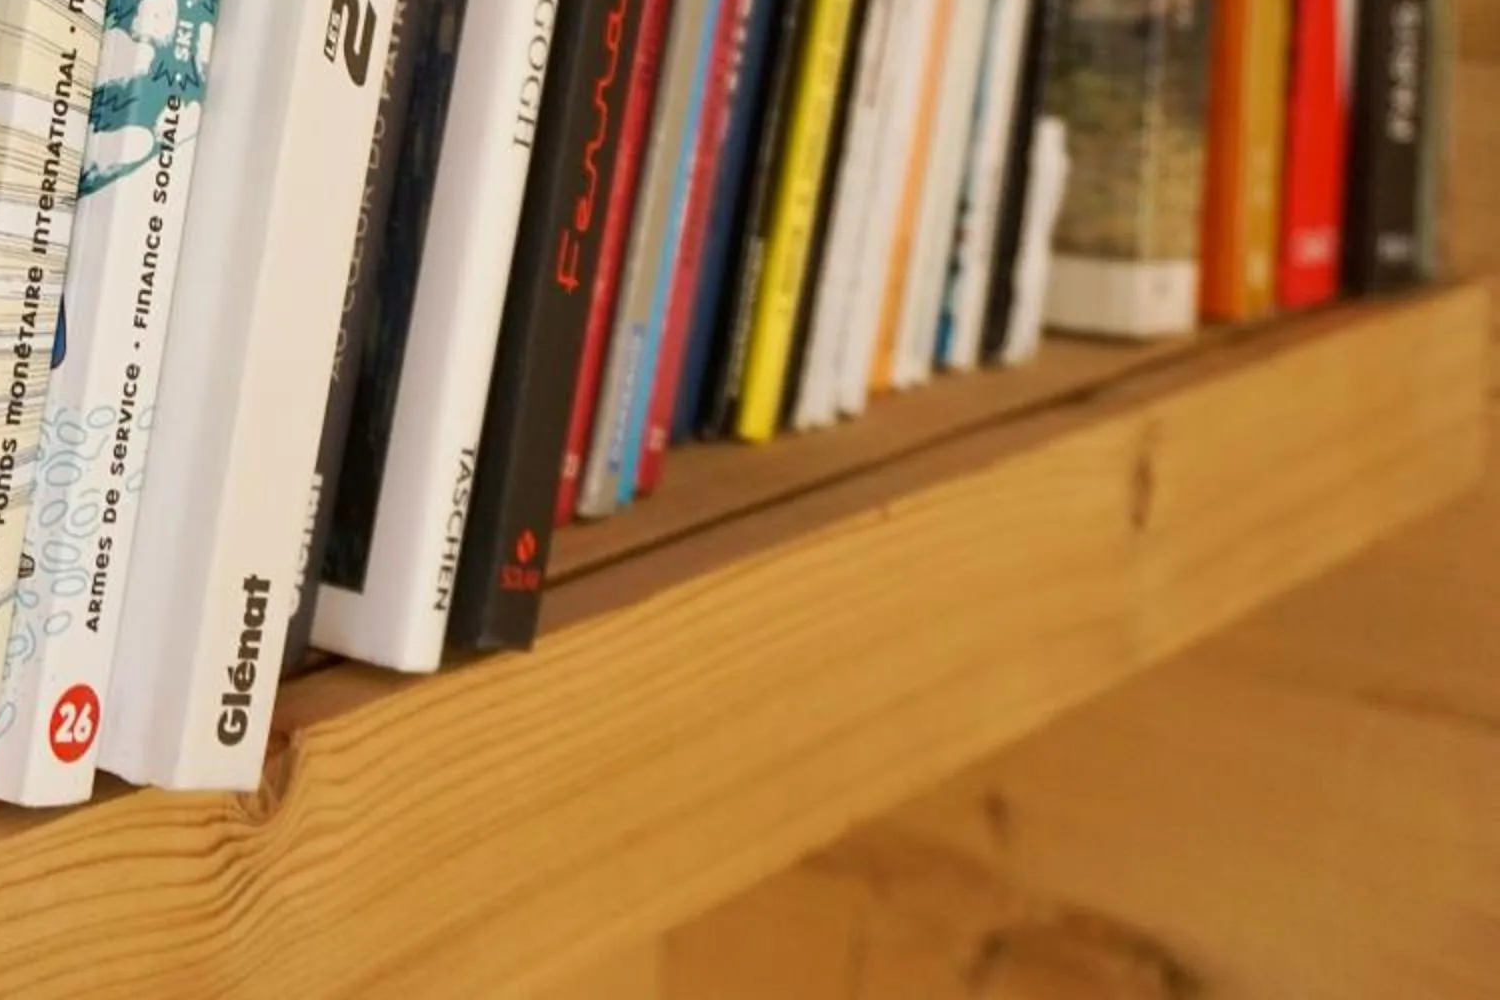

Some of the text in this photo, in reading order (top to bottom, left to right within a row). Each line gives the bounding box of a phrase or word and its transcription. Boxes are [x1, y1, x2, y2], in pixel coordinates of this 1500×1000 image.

[324, 10, 341, 61] LES
[101, 489, 120, 523] DE
[172, 19, 194, 62] SKI
[432, 444, 477, 611] TASCHEN
[55, 704, 93, 744] 26
[215, 574, 271, 748] Glénat
